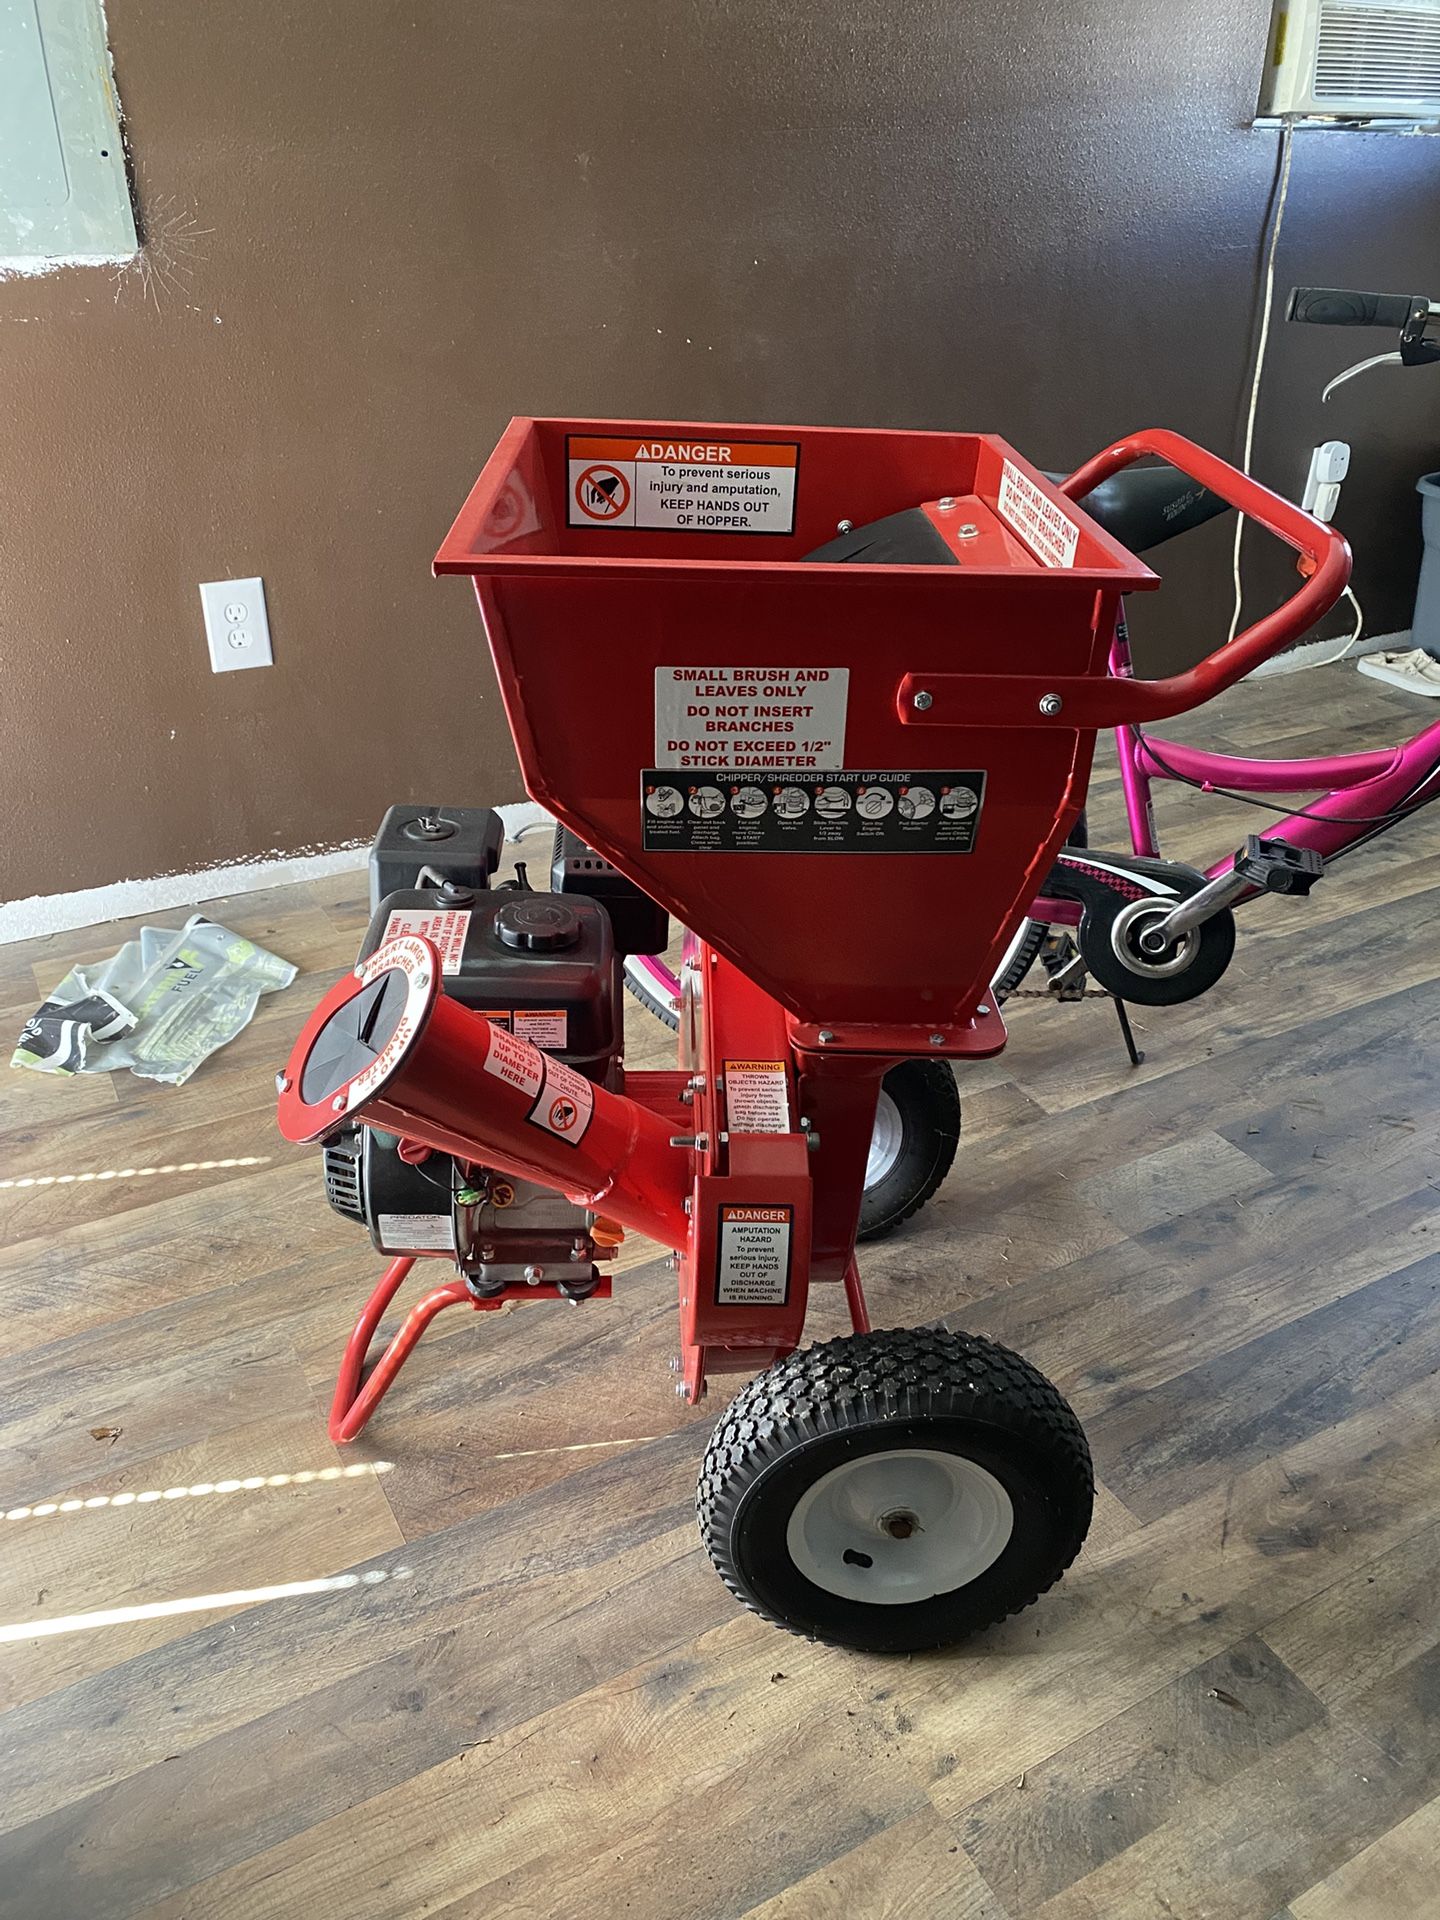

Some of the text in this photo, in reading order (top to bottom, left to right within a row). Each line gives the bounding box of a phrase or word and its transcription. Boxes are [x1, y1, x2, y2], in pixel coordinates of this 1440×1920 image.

[651, 444, 732, 462] DANGER
[662, 466, 770, 480] To prevent serious
[650, 481, 781, 498] injury and amputation,
[660, 499, 770, 512] KEEP HANDS OUT
[1016, 475, 1032, 499] BRUSH
[1032, 491, 1042, 510] AND
[1042, 500, 1062, 530] LEAVES
[1062, 521, 1078, 546] ONLY
[676, 515, 751, 528] OF HOPPER.
[1012, 491, 1022, 509] NOT
[1038, 518, 1066, 557] BRANCHES
[673, 670, 829, 682] SMALL BRUSH AND
[695, 686, 806, 696] LEAVES ONLY
[688, 706, 813, 717] DO NOT INSERT
[706, 721, 794, 732] BRANCHES
[668, 740, 831, 752] DO NOT EXCEED 1/2"
[680, 756, 816, 766] STICK DIAMETER
[716, 773, 911, 784] CHIPPER/SHREDDER START UP GUIDE
[388, 917, 401, 936] PANEL
[432, 916, 442, 930] AREA
[444, 912, 456, 928] START
[448, 915, 467, 968] ENGINE WILL NOT
[366, 940, 426, 972] INSERT LARGE
[371, 955, 415, 978] BRANCHES
[172, 968, 204, 993] FUEL
[399, 1028, 412, 1050] UP
[493, 1031, 540, 1063] BRANCHES
[358, 1017, 408, 1086] DIAMETER
[498, 1042, 511, 1053] UP
[512, 1050, 526, 1062] TO
[380, 1056, 396, 1076] TO
[493, 1050, 539, 1082] DIAMETER
[500, 1066, 526, 1086] HERE
[548, 1068, 592, 1097] OUT OF CHIPPER
[737, 1210, 786, 1220] DANGER
